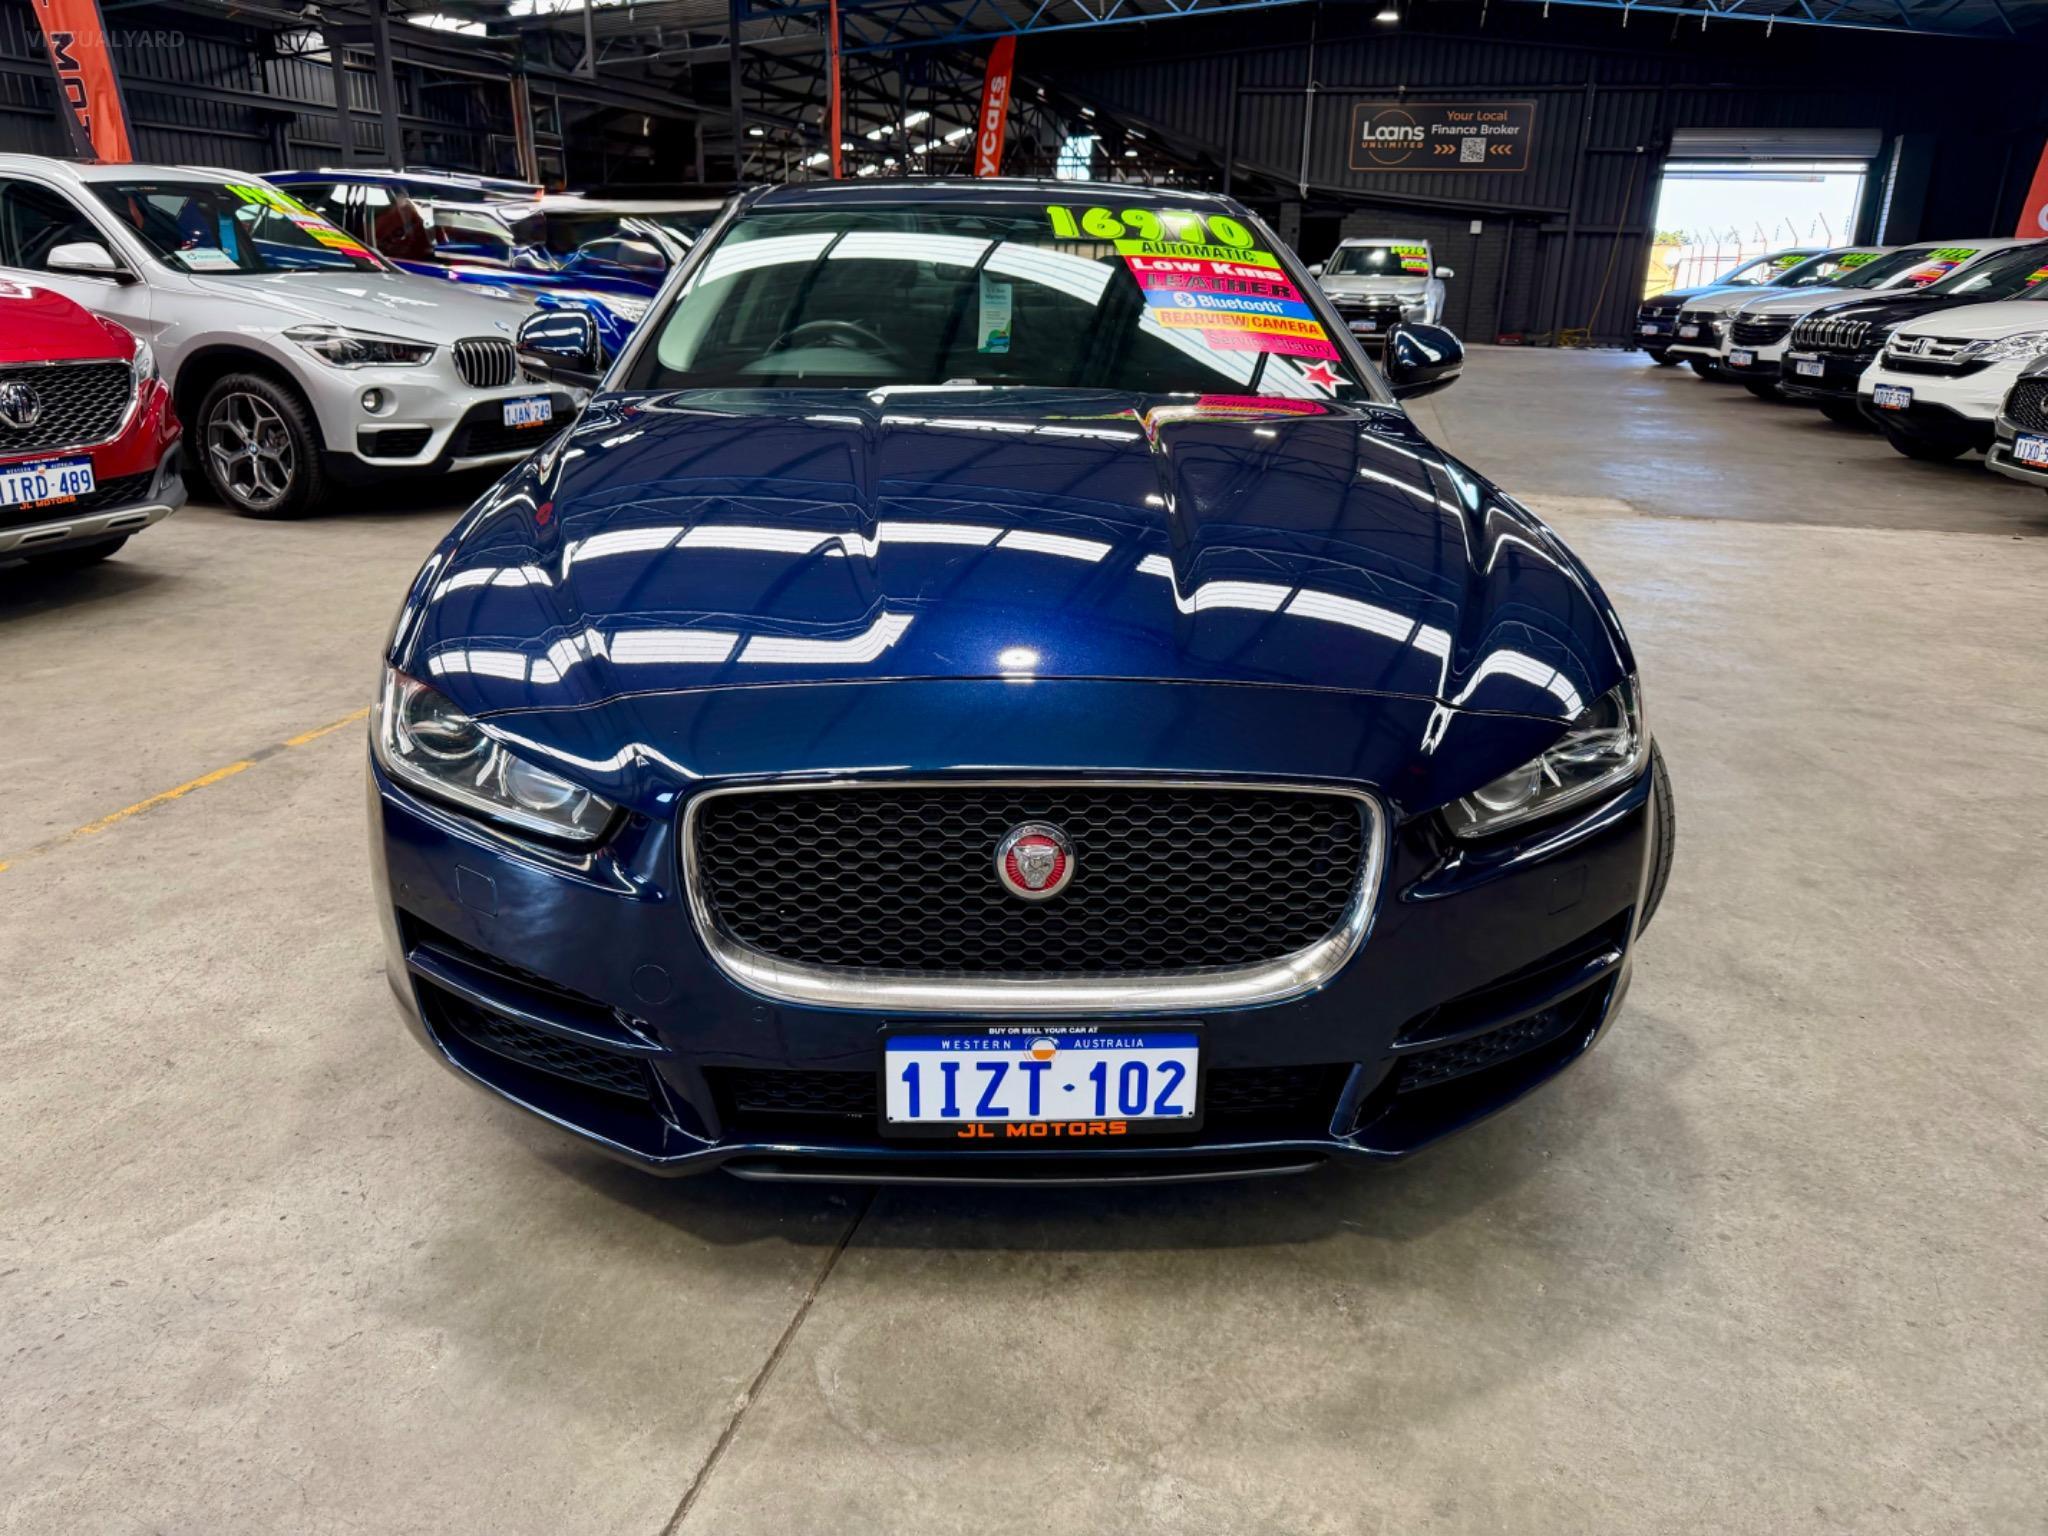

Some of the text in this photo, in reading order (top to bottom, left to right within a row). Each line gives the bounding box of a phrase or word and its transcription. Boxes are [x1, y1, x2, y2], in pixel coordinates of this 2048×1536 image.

[1447, 110, 1507, 121] Your Local
[1362, 121, 1425, 140] Loans
[1431, 124, 1520, 135] Finance Broker
[1046, 205, 1254, 249] 16970
[1141, 240, 1257, 263] AUTOMATIC
[1146, 273, 1292, 299] LEATHER
[1199, 294, 1283, 314] Bluetooth
[1160, 310, 1320, 335] REARVIEW CAMERA
[989, 1027, 1006, 1035] BUY
[941, 1038, 1144, 1050] WESTERN AUSTRALIA
[957, 1120, 1127, 1139] JL MOTORS
